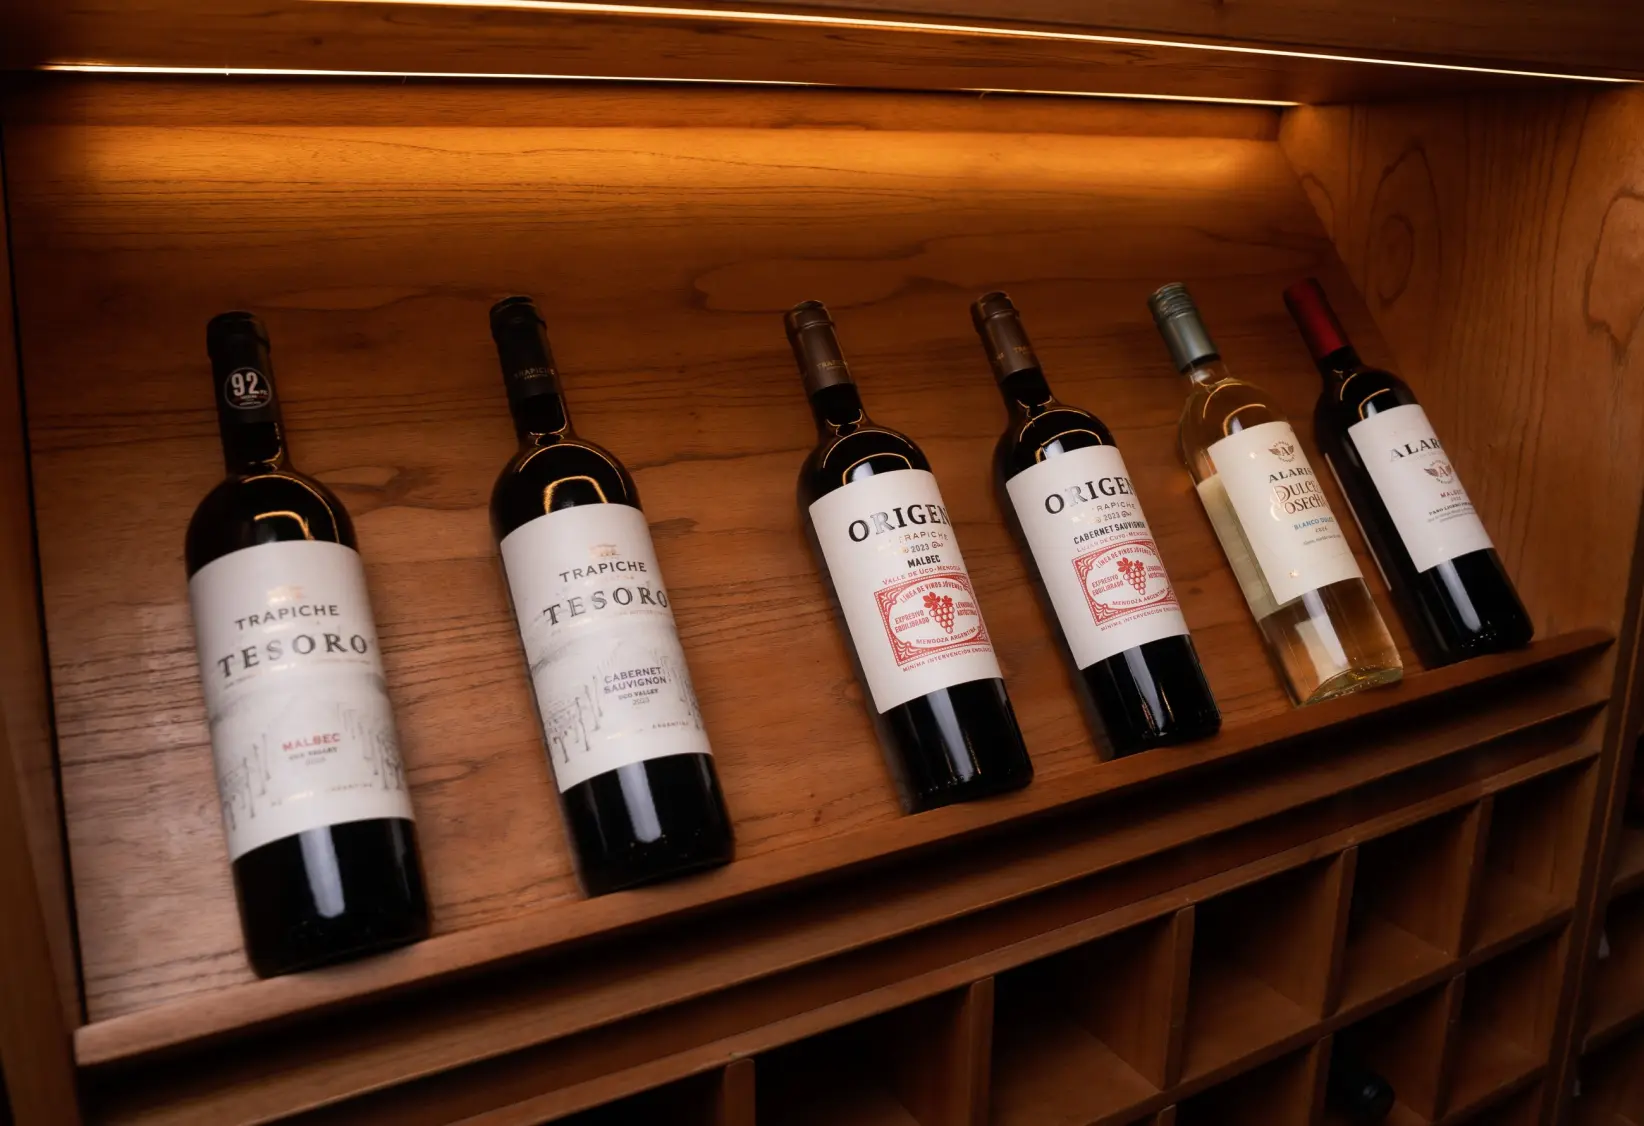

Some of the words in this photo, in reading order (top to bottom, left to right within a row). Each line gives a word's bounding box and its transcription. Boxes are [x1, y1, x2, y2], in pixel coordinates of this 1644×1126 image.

[231, 372, 260, 397] 92
[848, 504, 951, 543] ORIGEN
[1073, 525, 1114, 545] CABERNET
[911, 543, 930, 553] 2023
[907, 554, 941, 569] MALBEC
[559, 561, 647, 583] TRAPICHE
[542, 586, 669, 627] TESORO
[234, 604, 340, 631] TRAPICHE
[217, 632, 368, 679] TESORO
[603, 676, 667, 695] SAUVIGNON
[604, 667, 662, 684] CABERNET
[633, 688, 660, 697] VALLEY
[281, 732, 341, 752] MALBEC
